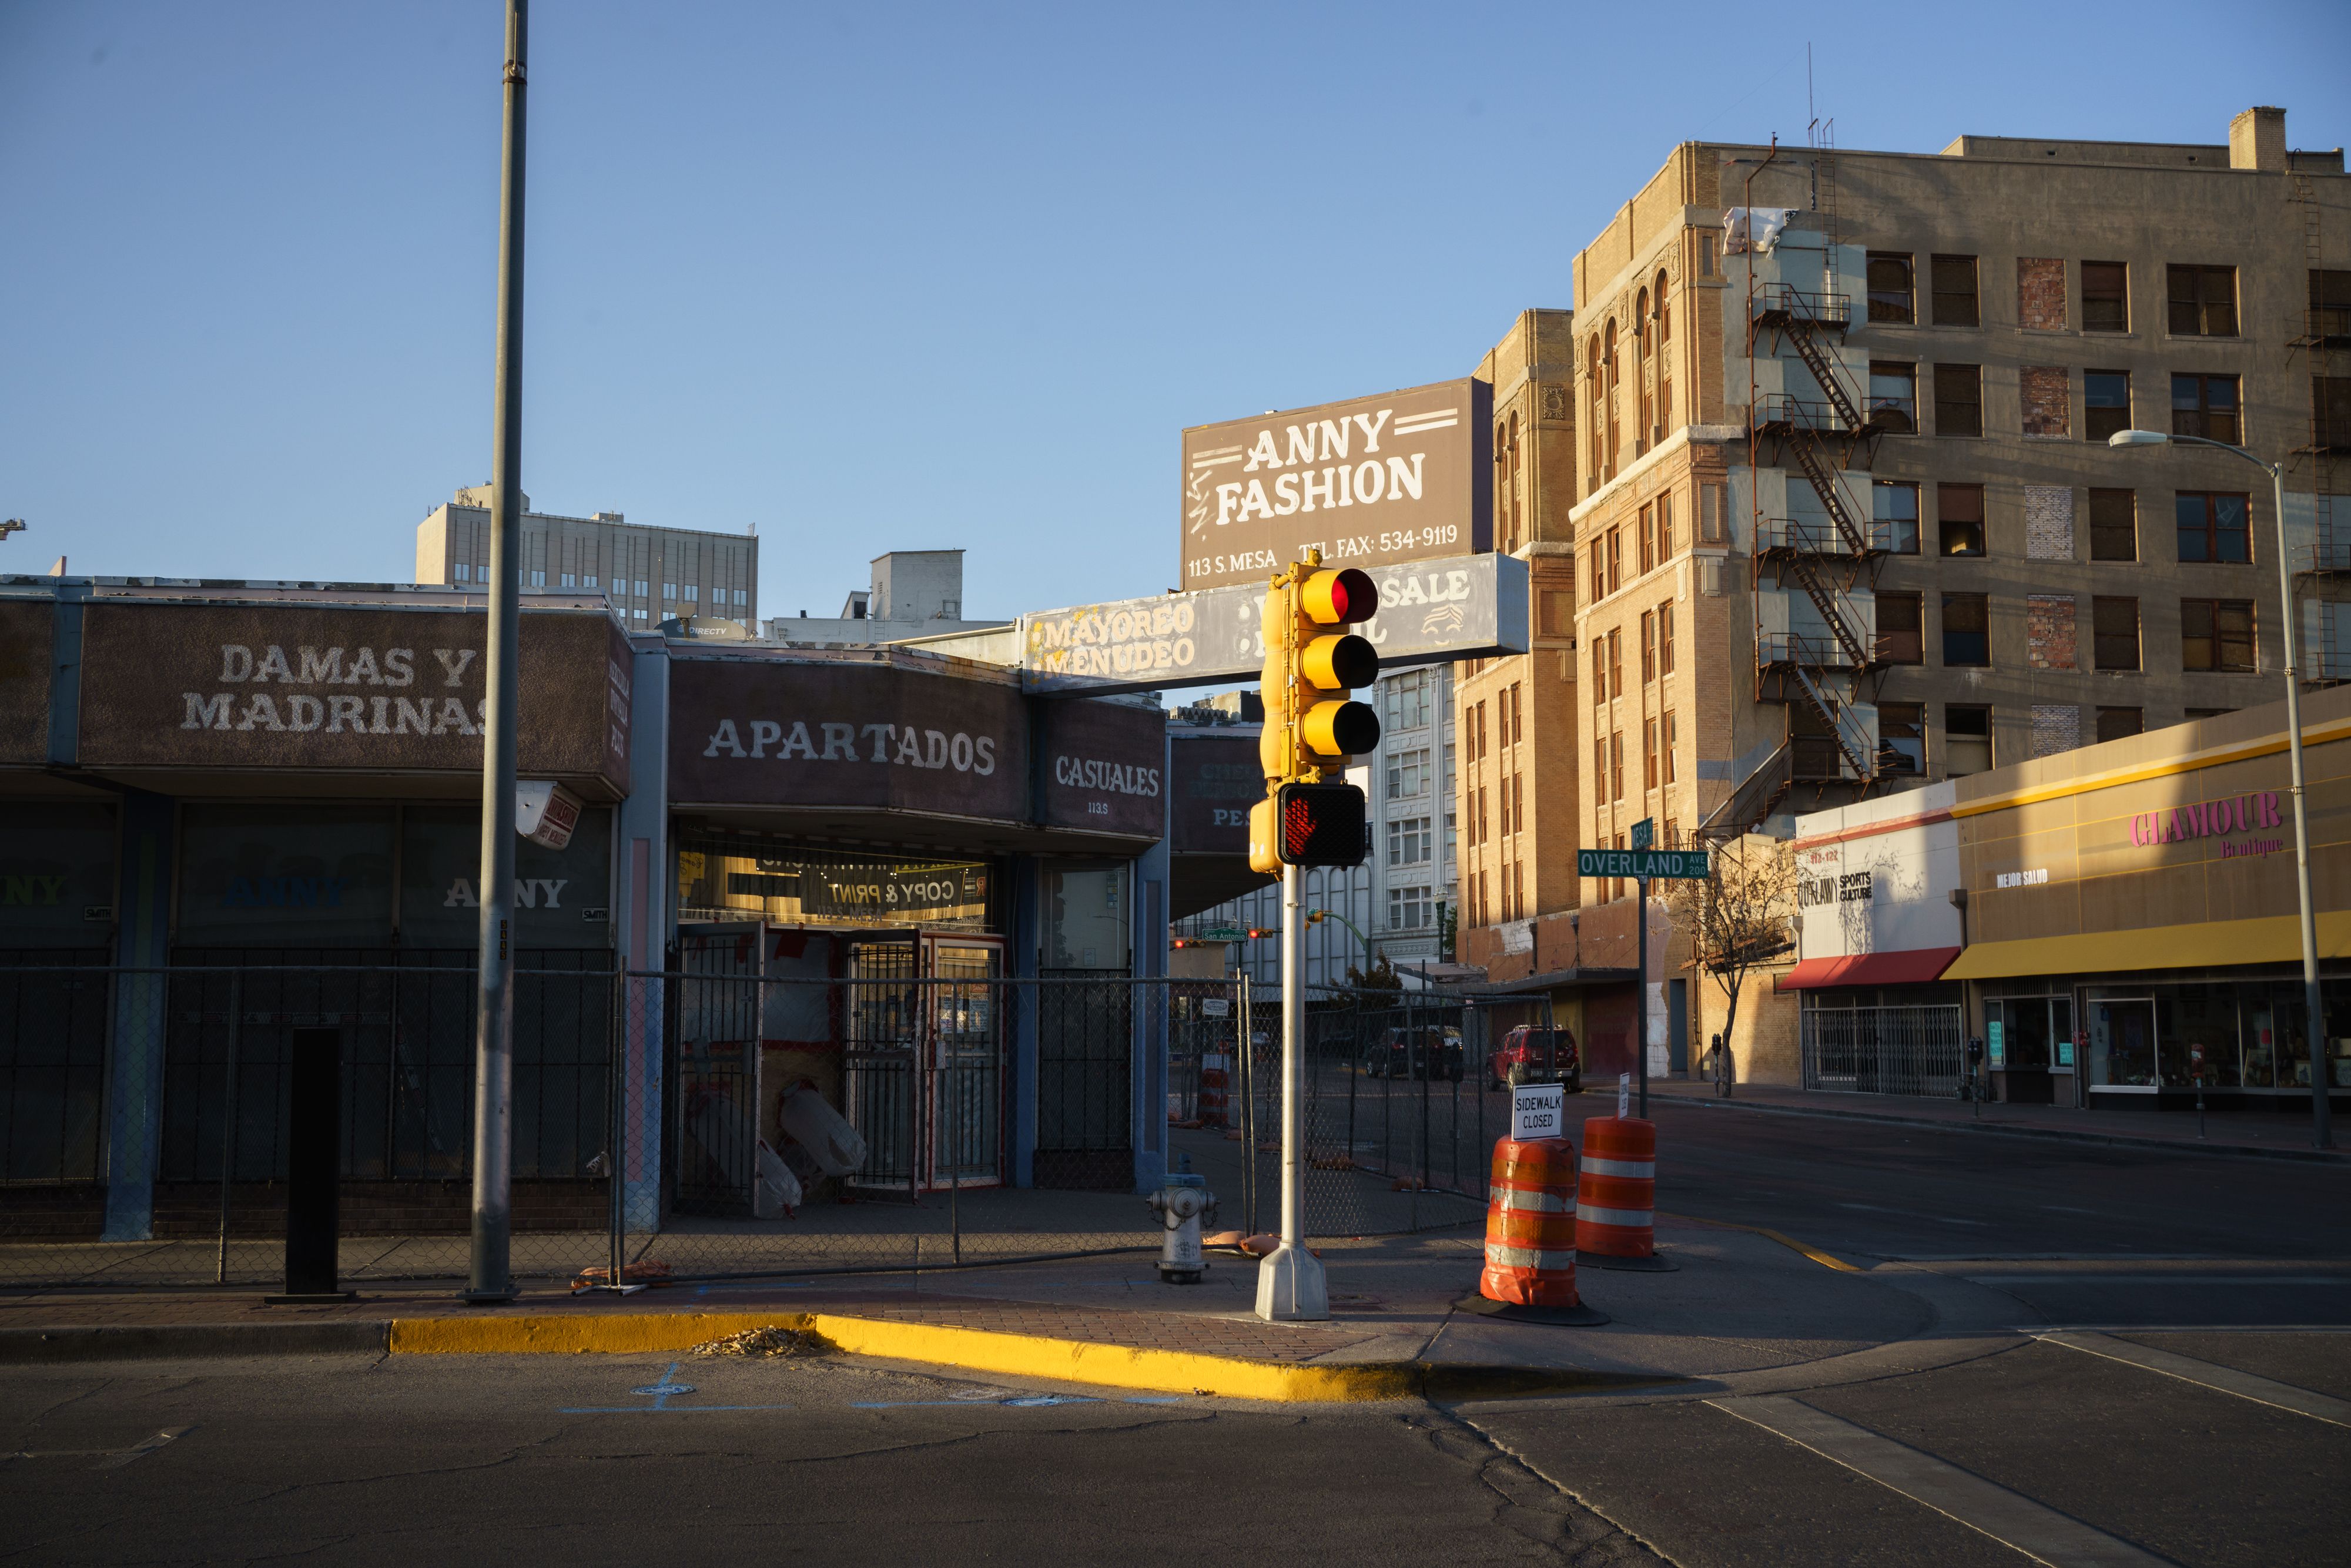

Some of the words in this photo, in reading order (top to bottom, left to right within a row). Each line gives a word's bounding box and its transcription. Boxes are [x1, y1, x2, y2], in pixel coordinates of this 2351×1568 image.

[1243, 410, 1393, 473] ANNY
[1215, 453, 1425, 525] FASHION
[1188, 559, 1211, 577] 113
[1230, 550, 1278, 572] MESA
[1337, 535, 1374, 559] FAX:
[1380, 524, 1458, 552] 534-9119
[1044, 602, 1194, 649] MAYOREO
[218, 644, 415, 687] DAMAS
[434, 649, 476, 687] Y
[1044, 638, 1195, 677] MENUDEO
[703, 719, 996, 776] APARTADOS
[1055, 755, 1159, 798] CASUALES
[2129, 792, 2283, 847] GLAMOUR
[1632, 824, 1648, 848] MESA
[1581, 853, 1683, 875] OVERLAND
[1689, 855, 1706, 864] AVE
[1689, 866, 1706, 875] 200
[1840, 871, 1871, 889] SPORTS
[1997, 872, 2022, 889] MEJOR
[2023, 868, 2048, 886] SALUD
[443, 878, 568, 908] ANY
[1840, 887, 1873, 902] CULTURE
[86, 909, 111, 918] SMITH
[584, 910, 607, 919] SMITH
[818, 905, 832, 919] 113
[849, 906, 882, 922] MESA
[1516, 1096, 1561, 1111] SIDEWALK
[1523, 1114, 1553, 1128] CLOSED
